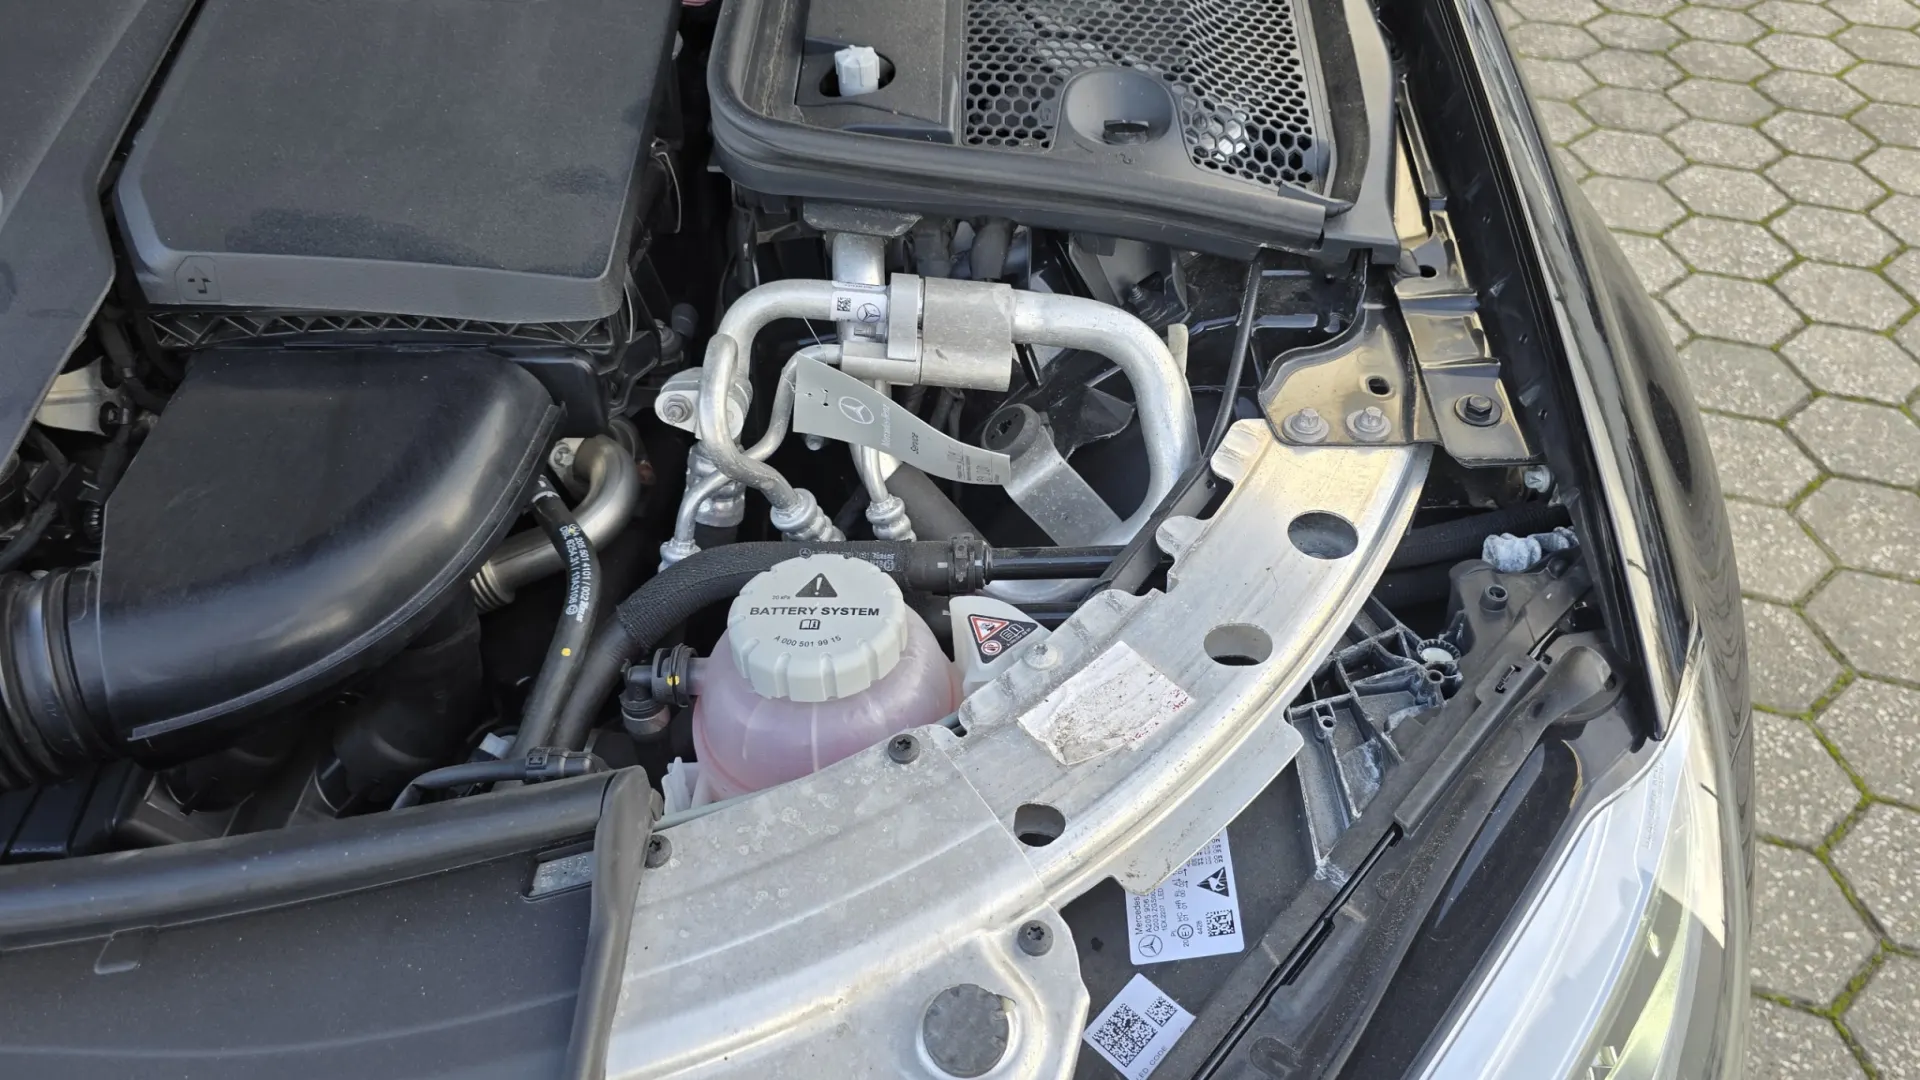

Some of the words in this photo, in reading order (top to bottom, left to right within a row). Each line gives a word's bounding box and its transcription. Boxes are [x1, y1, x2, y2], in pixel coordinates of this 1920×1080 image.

[910, 432, 919, 454] Service
[574, 536, 587, 549] 205
[580, 586, 590, 601] 002
[749, 606, 818, 616] BATTERY
[820, 606, 880, 616] SYSTEM
[781, 637, 798, 647] 000
[831, 635, 842, 643] 15
[1143, 898, 1151, 912] 906
[1133, 896, 1143, 936] Mercedes
[1181, 926, 1190, 937] E1
[1183, 939, 1190, 948] 20
[1149, 1046, 1168, 1066] CODE
